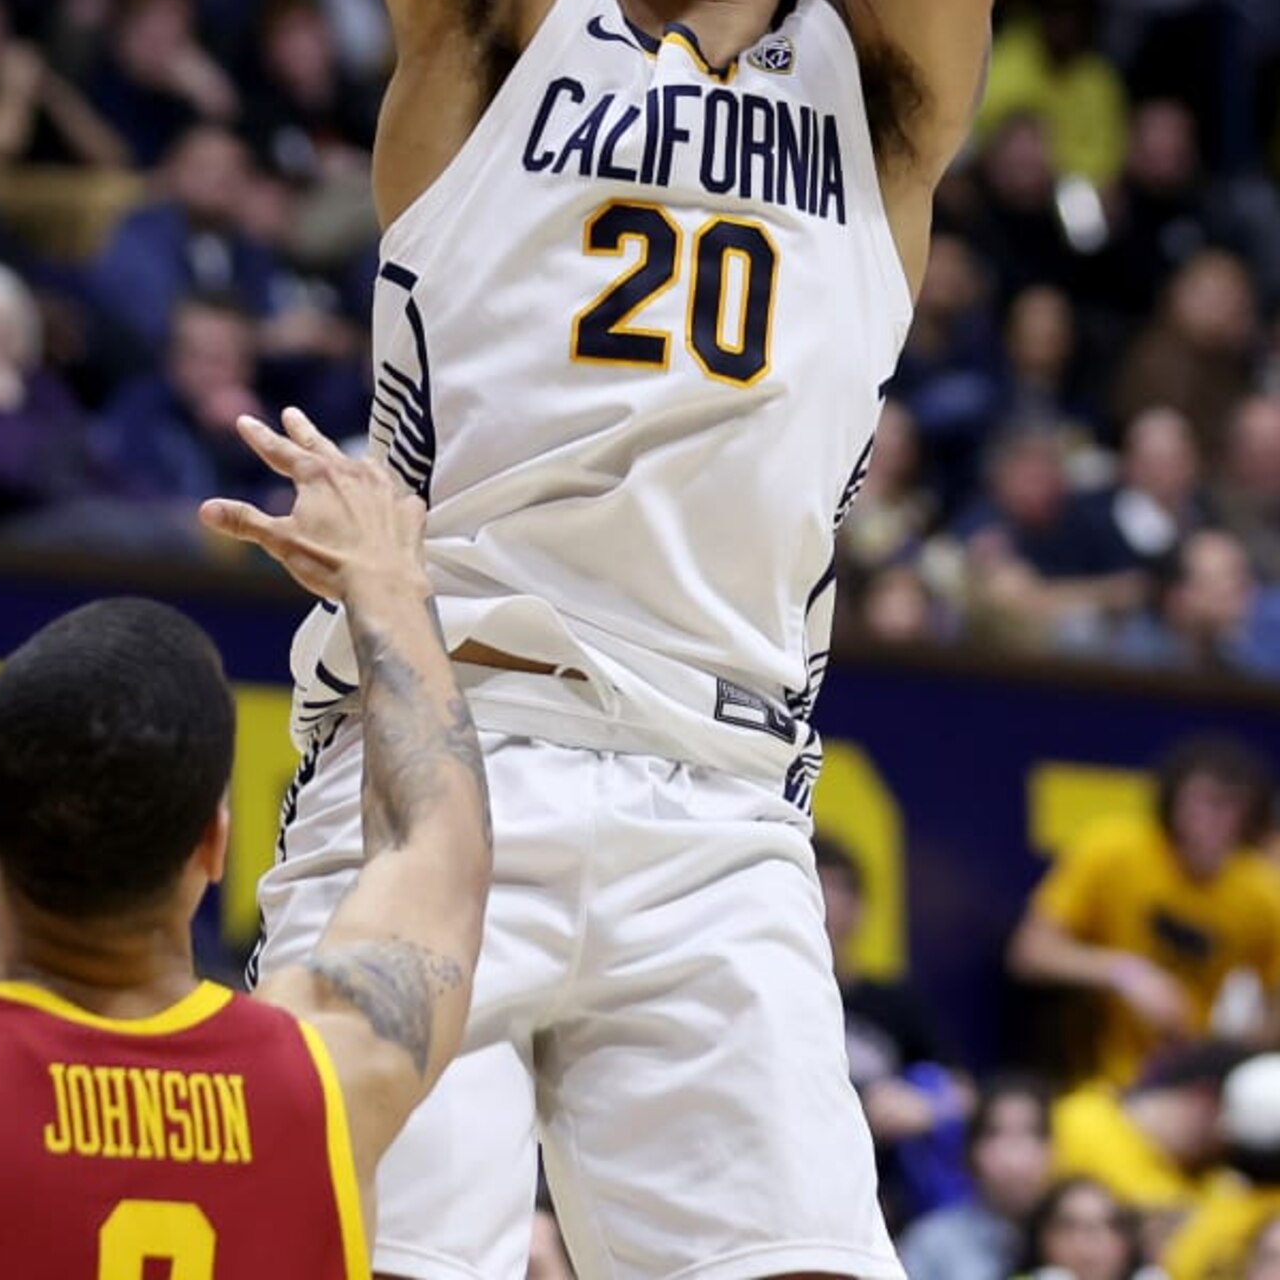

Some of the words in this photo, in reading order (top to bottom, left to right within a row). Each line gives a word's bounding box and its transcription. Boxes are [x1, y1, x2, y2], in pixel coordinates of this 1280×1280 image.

[522, 77, 846, 225] CALIFORNIA
[569, 197, 781, 388] 20
[44, 1063, 252, 1163] JOHNSON
